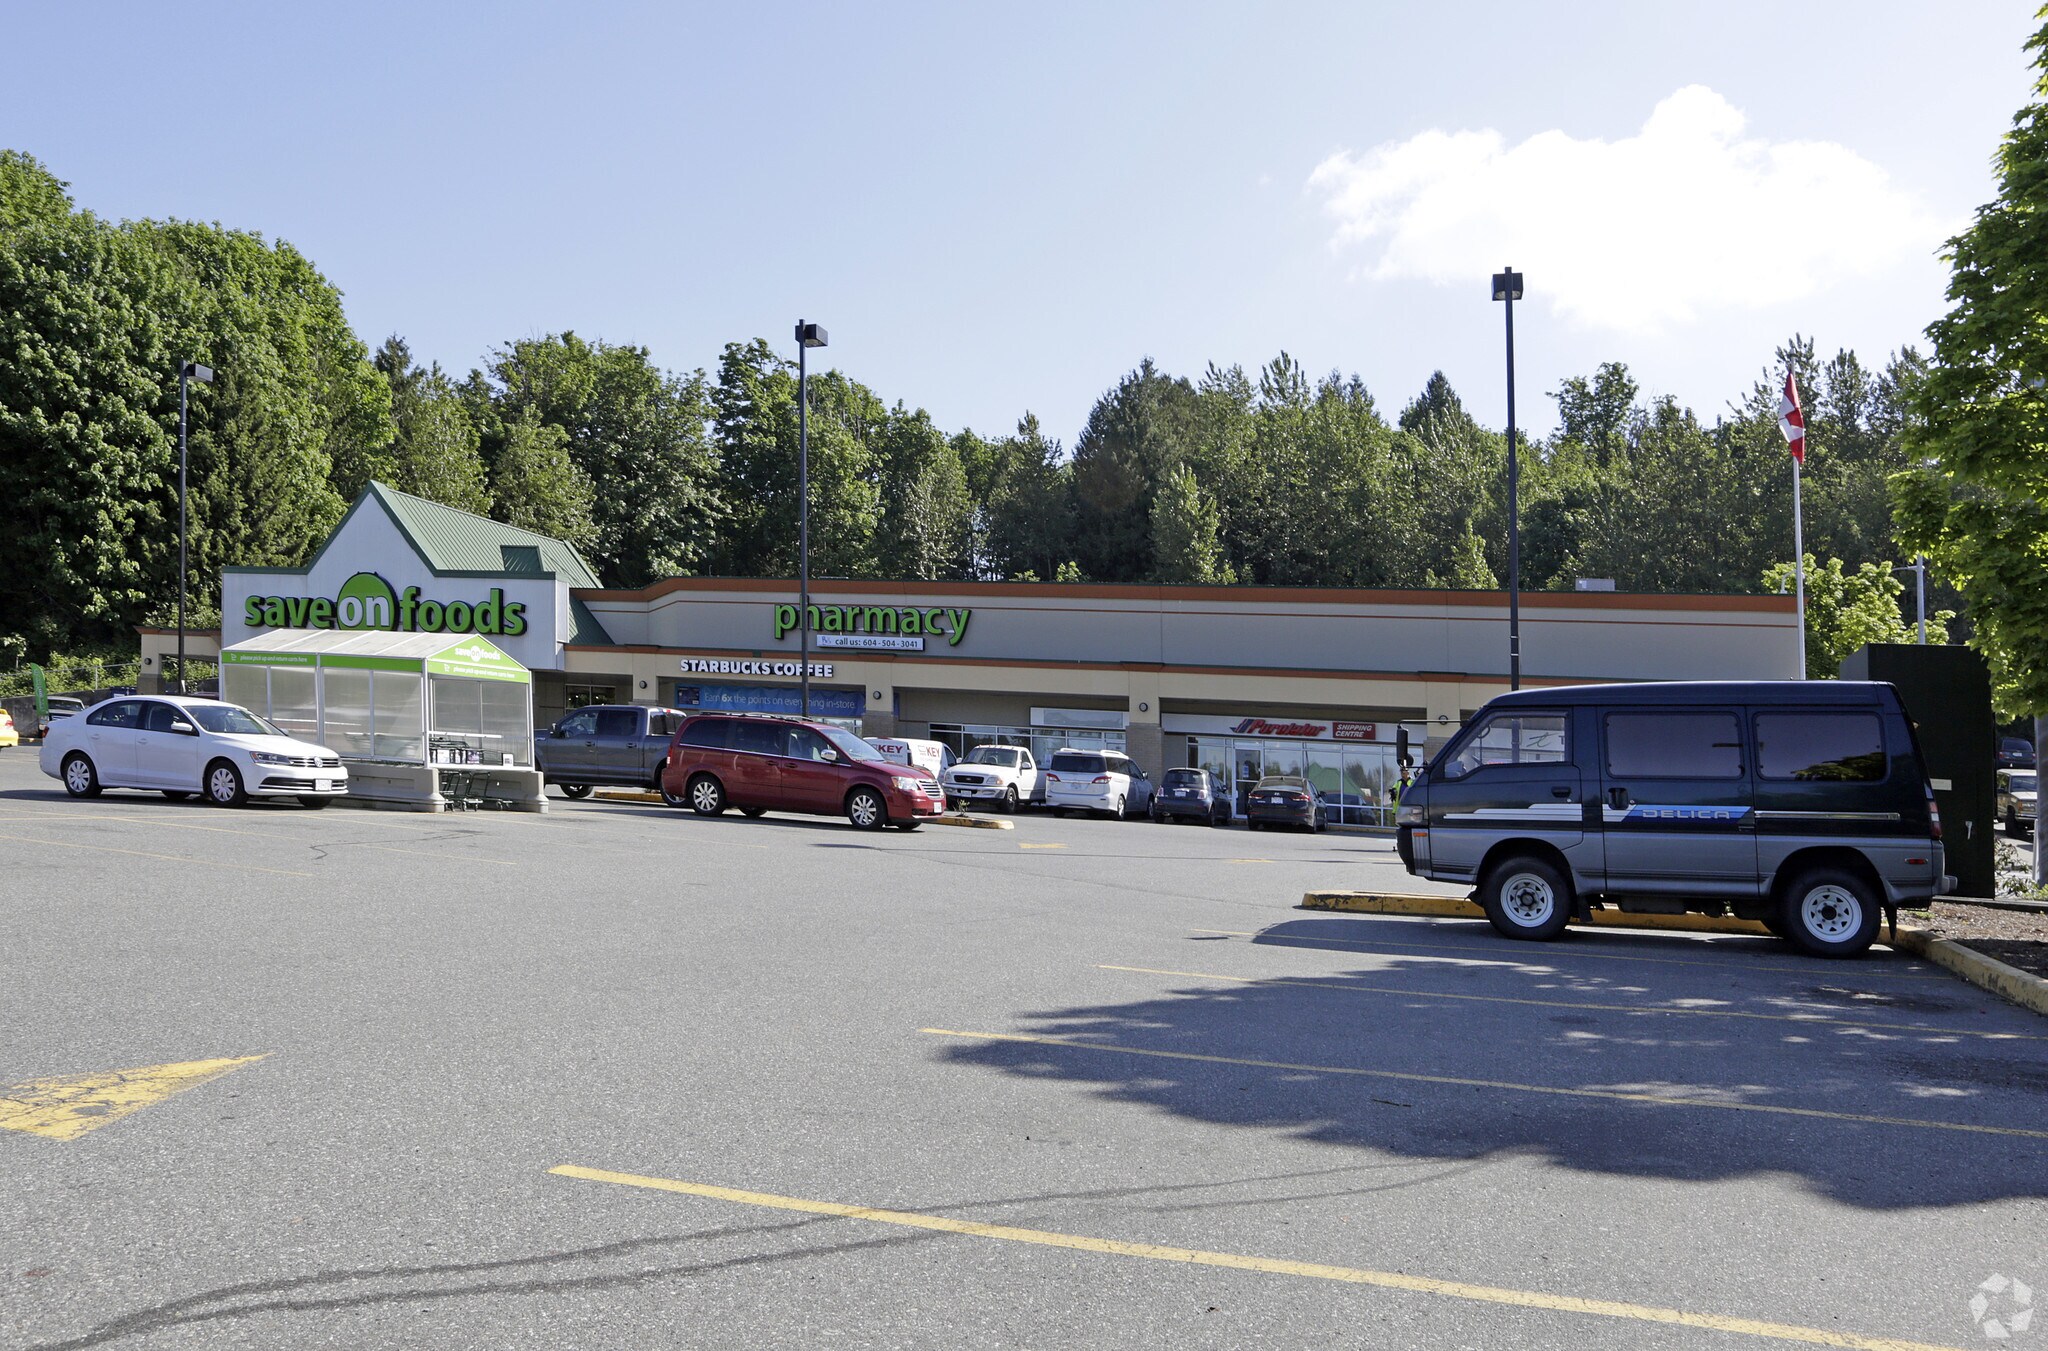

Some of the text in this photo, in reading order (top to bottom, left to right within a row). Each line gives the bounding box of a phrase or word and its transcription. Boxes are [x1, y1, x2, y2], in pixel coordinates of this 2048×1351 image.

[774, 594, 972, 647] pharmacy
[835, 637, 848, 646] call
[849, 638, 861, 646] us:
[680, 659, 833, 677] STARBUCKS COFFEE
[704, 692, 721, 703] Earn
[721, 693, 733, 703] 6x
[734, 693, 747, 703] the
[747, 694, 771, 707] points
[772, 696, 783, 705] on
[784, 694, 824, 710] everyhing
[1247, 719, 1327, 737] Purolator
[1336, 724, 1372, 732] SHIPPING
[1335, 730, 1365, 738] CENTRE
[878, 744, 903, 754] KEY
[926, 746, 940, 757] KEY
[1642, 809, 1730, 819] DELICA
